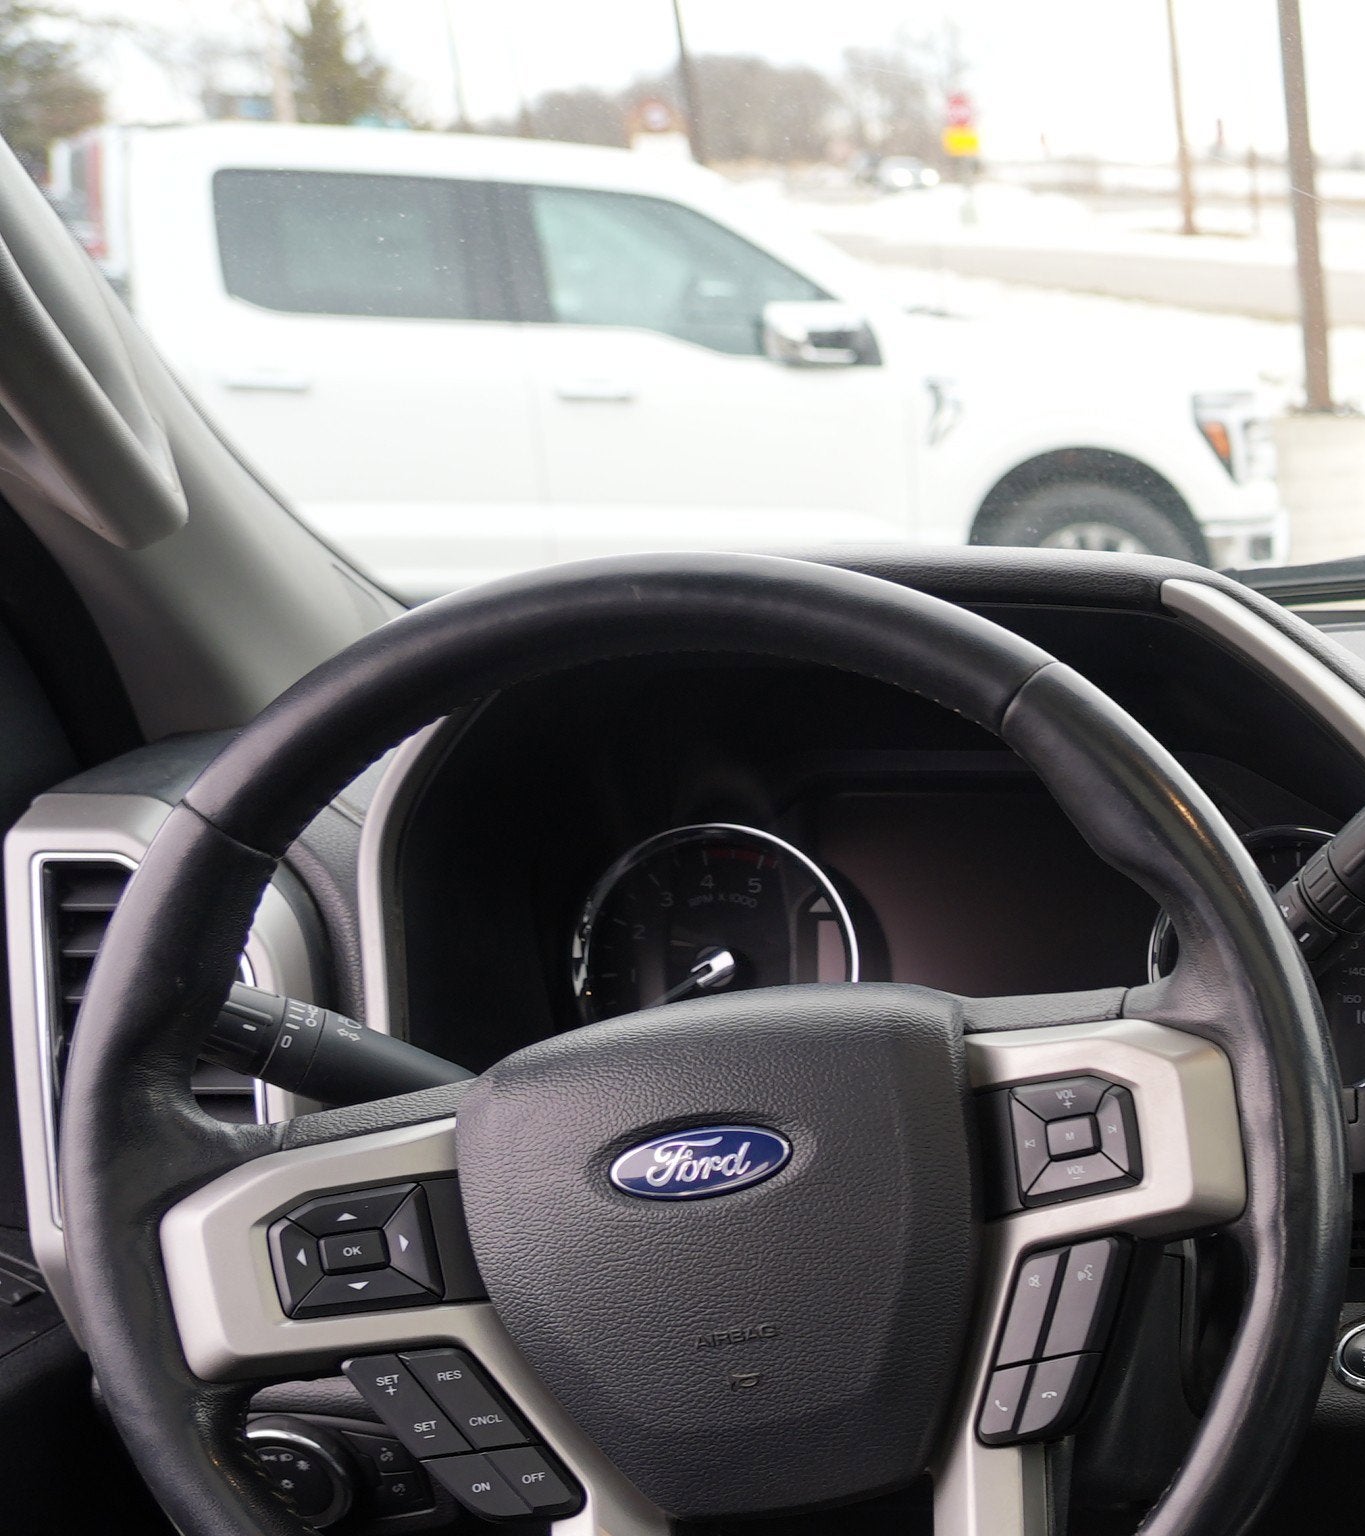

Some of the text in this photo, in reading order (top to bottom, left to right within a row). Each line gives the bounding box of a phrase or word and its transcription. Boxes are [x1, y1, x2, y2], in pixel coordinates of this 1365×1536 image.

[699, 874, 715, 889] 4
[747, 877, 763, 893] 5
[659, 892, 675, 908] 3
[632, 925, 647, 940] 2
[1055, 1088, 1076, 1101] VOL
[645, 1135, 751, 1189] Ford
[1065, 1164, 1086, 1177] VOL
[342, 1243, 363, 1258] OK
[695, 1324, 778, 1350] AIRBAG
[376, 1373, 399, 1387] SET
[436, 1369, 462, 1382] RES
[413, 1419, 437, 1433] SET
[468, 1412, 503, 1427] CNCL
[521, 1470, 546, 1485] OFF
[471, 1480, 491, 1494] ON
